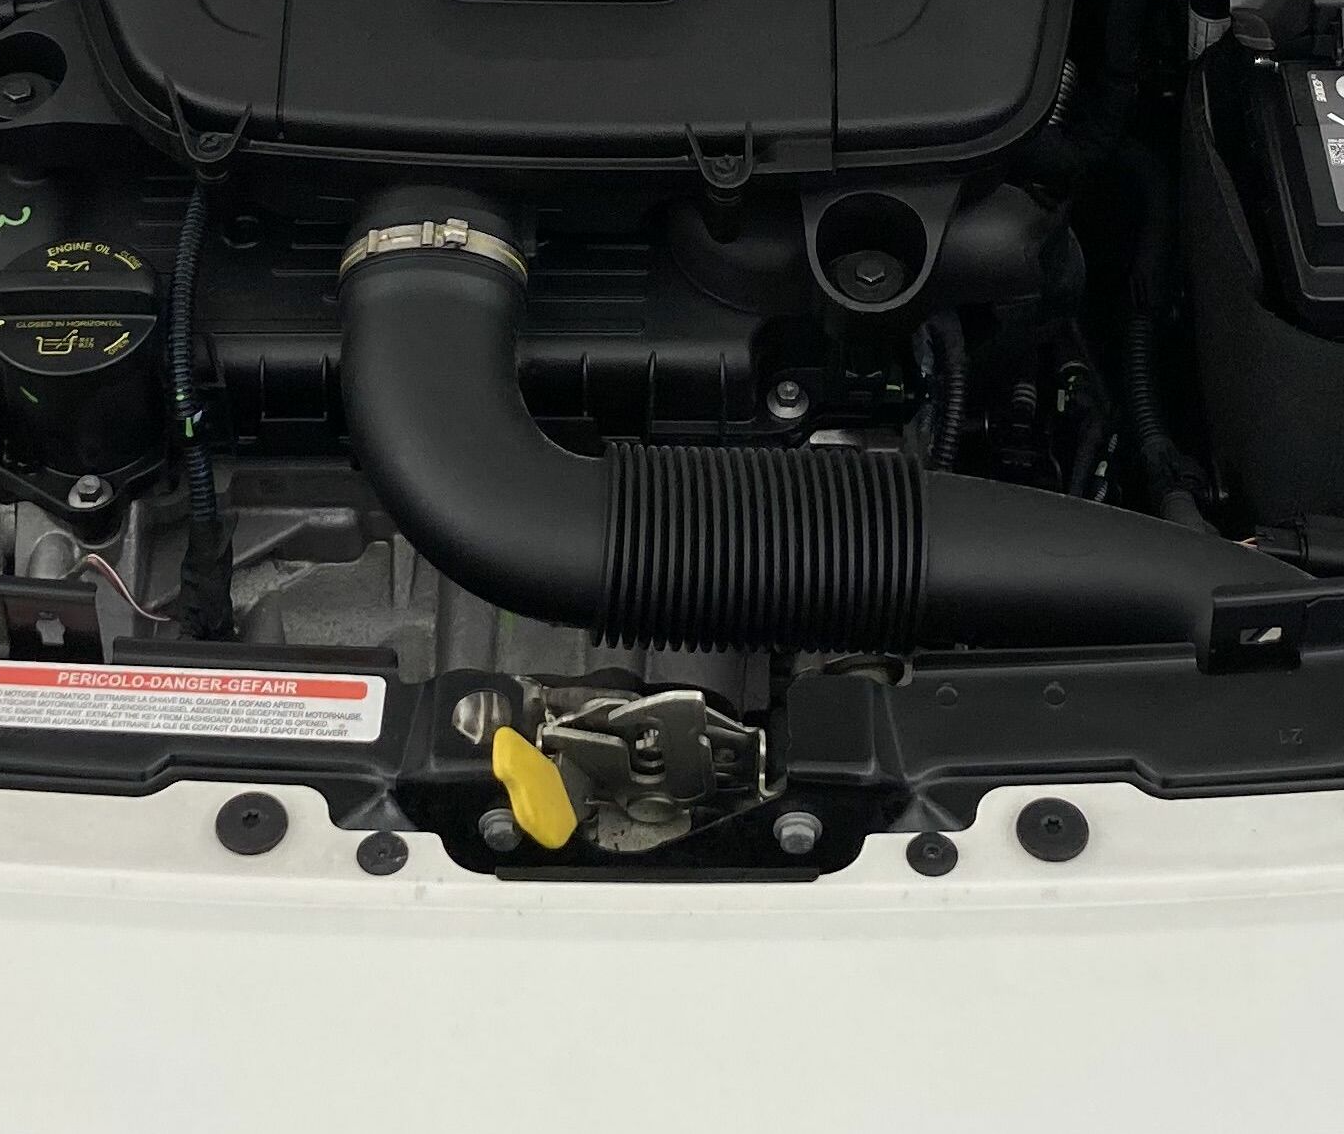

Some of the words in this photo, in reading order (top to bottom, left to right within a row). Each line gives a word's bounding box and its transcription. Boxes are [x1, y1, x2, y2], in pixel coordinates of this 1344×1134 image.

[47, 242, 94, 257] ENGINE
[94, 244, 112, 255] OIL
[57, 672, 298, 694] PERICOLO-DANGER-GEFAHR
[5, 690, 38, 698] MOTORE
[94, 693, 136, 703] ESTRARRE
[149, 697, 177, 705] CHIAVE
[179, 697, 194, 705] DAL
[196, 697, 230, 706] QUADRO
[239, 699, 271, 709] COFANO
[14, 707, 45, 716] ENGINE
[86, 710, 123, 719] EXTRACT
[142, 712, 158, 720] KEY
[159, 713, 182, 723] FROM
[183, 715, 232, 725] DASHBOARD
[234, 717, 259, 726] WHEN
[260, 718, 284, 727] HOOD
[191, 706, 230, 715] ABZIEHEN
[231, 707, 245, 715] BEI
[17, 716, 51, 725] MOTEUR
[112, 720, 151, 729] EXTRAIRE
[192, 723, 228, 733] CONTACT
[230, 724, 258, 733] QUAND
[259, 726, 269, 734] LE
[270, 726, 298, 735] CAPOT
[299, 727, 315, 735] EST
